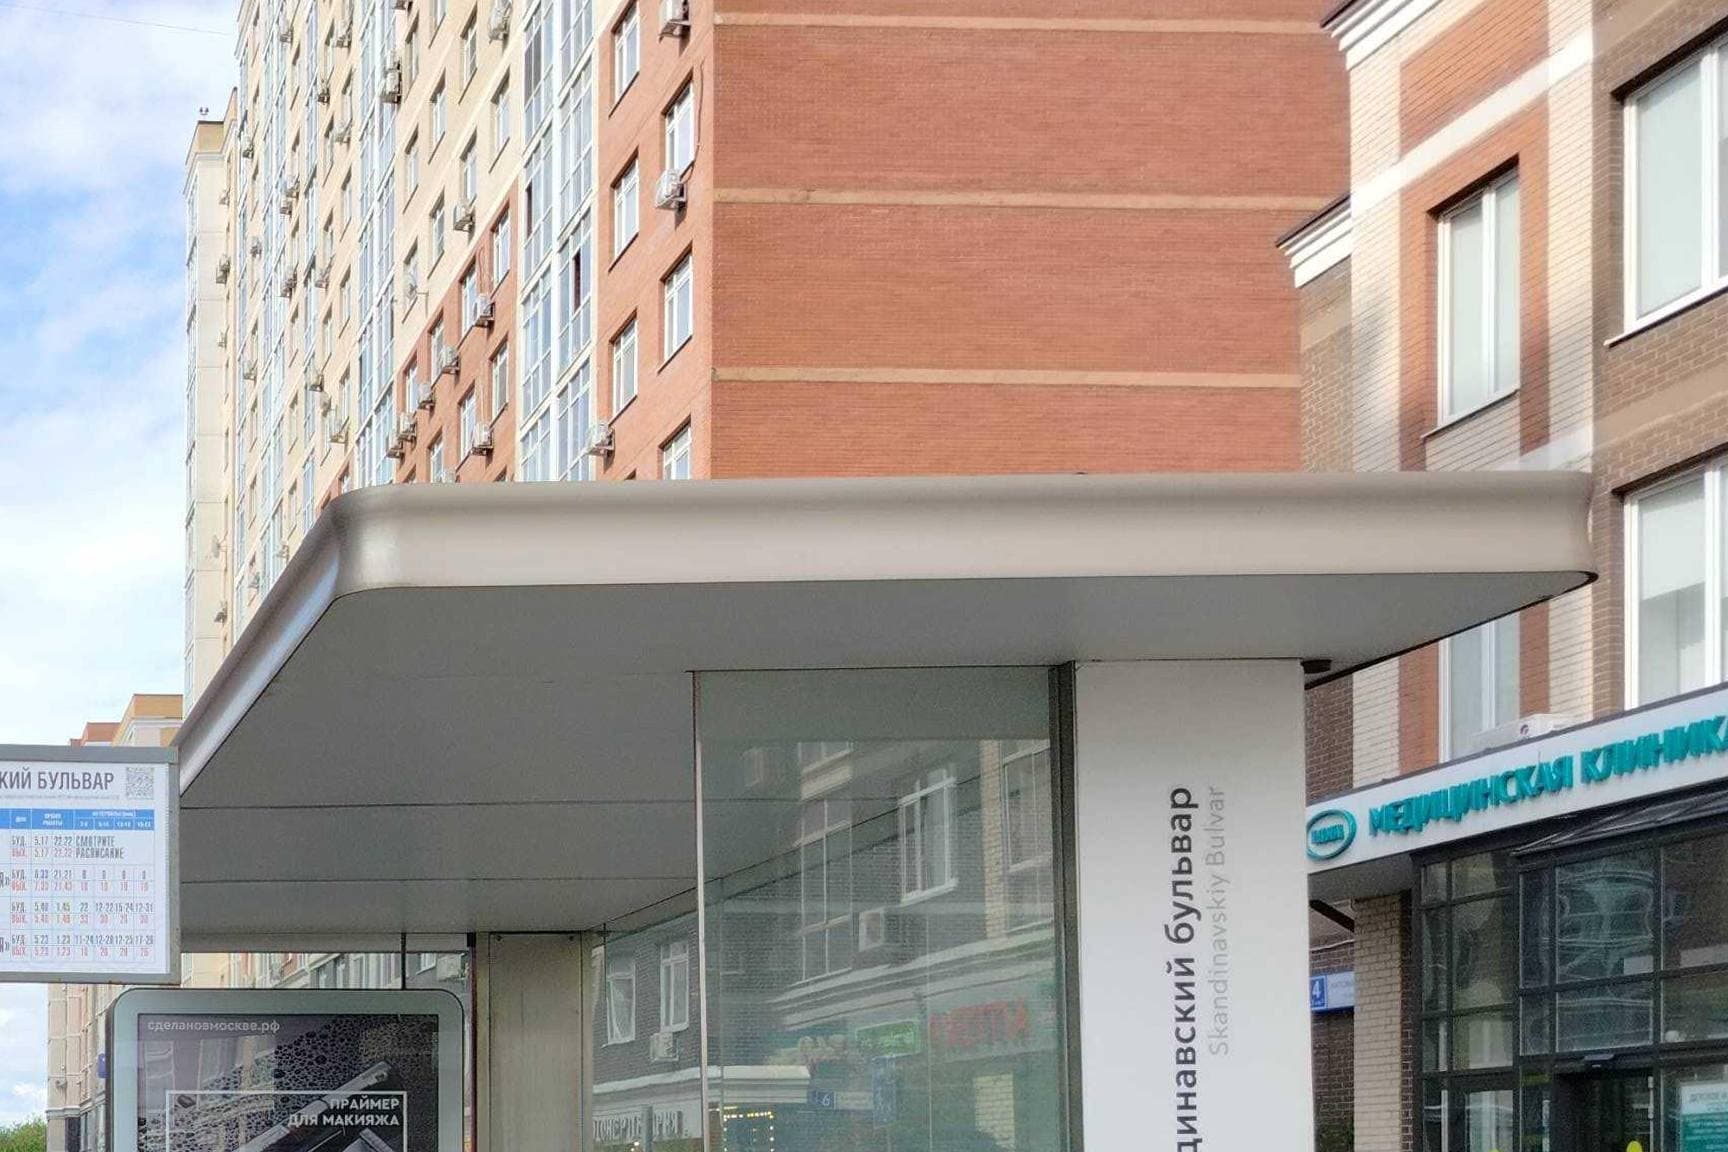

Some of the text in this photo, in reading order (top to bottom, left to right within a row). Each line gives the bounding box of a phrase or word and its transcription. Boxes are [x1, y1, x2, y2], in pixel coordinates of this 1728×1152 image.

[38, 772, 115, 791] БУЛЬВАР
[1369, 714, 1728, 836] МЕДИЦИНСКАЯ КЛИНИК
[1164, 786, 1201, 943] бульвар
[1206, 786, 1231, 1056] Skandinavskiy Bulvar
[147, 1019, 280, 1034] сделановмоскве.рф
[329, 1095, 400, 1110] ПРАЙМЕР
[287, 1114, 400, 1128] ДЛЯ МАКИЯЖА
